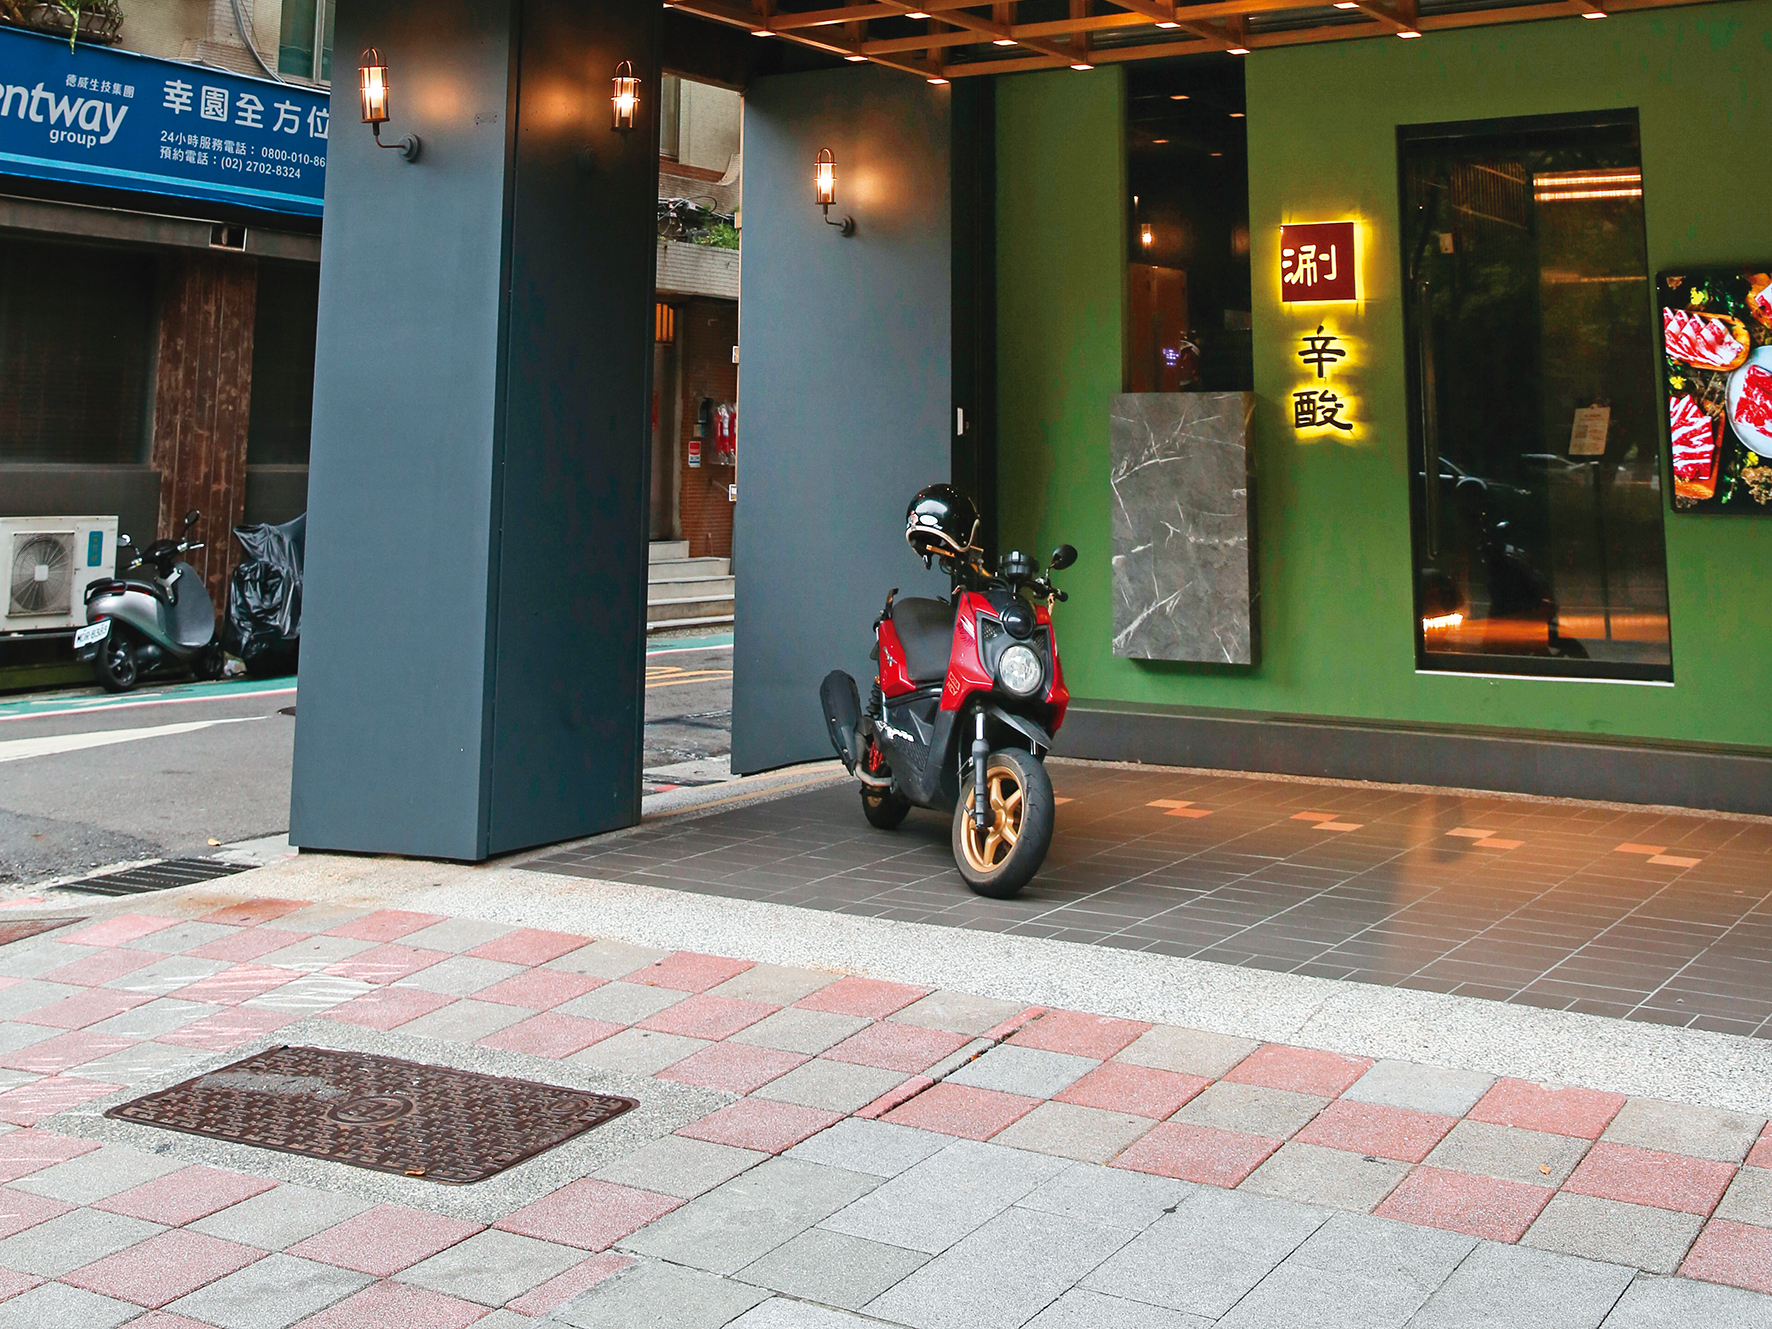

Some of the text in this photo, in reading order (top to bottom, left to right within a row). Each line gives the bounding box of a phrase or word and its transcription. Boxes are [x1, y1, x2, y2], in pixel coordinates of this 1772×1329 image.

[65, 74, 135, 99] 德威生技集團
[0, 82, 129, 145] ntway
[163, 79, 330, 139] 幸園全方位
[49, 129, 97, 149] group
[246, 161, 301, 179] 2702-8324
[1282, 244, 1337, 287] 涮
[1293, 324, 1354, 431] 辛酸
